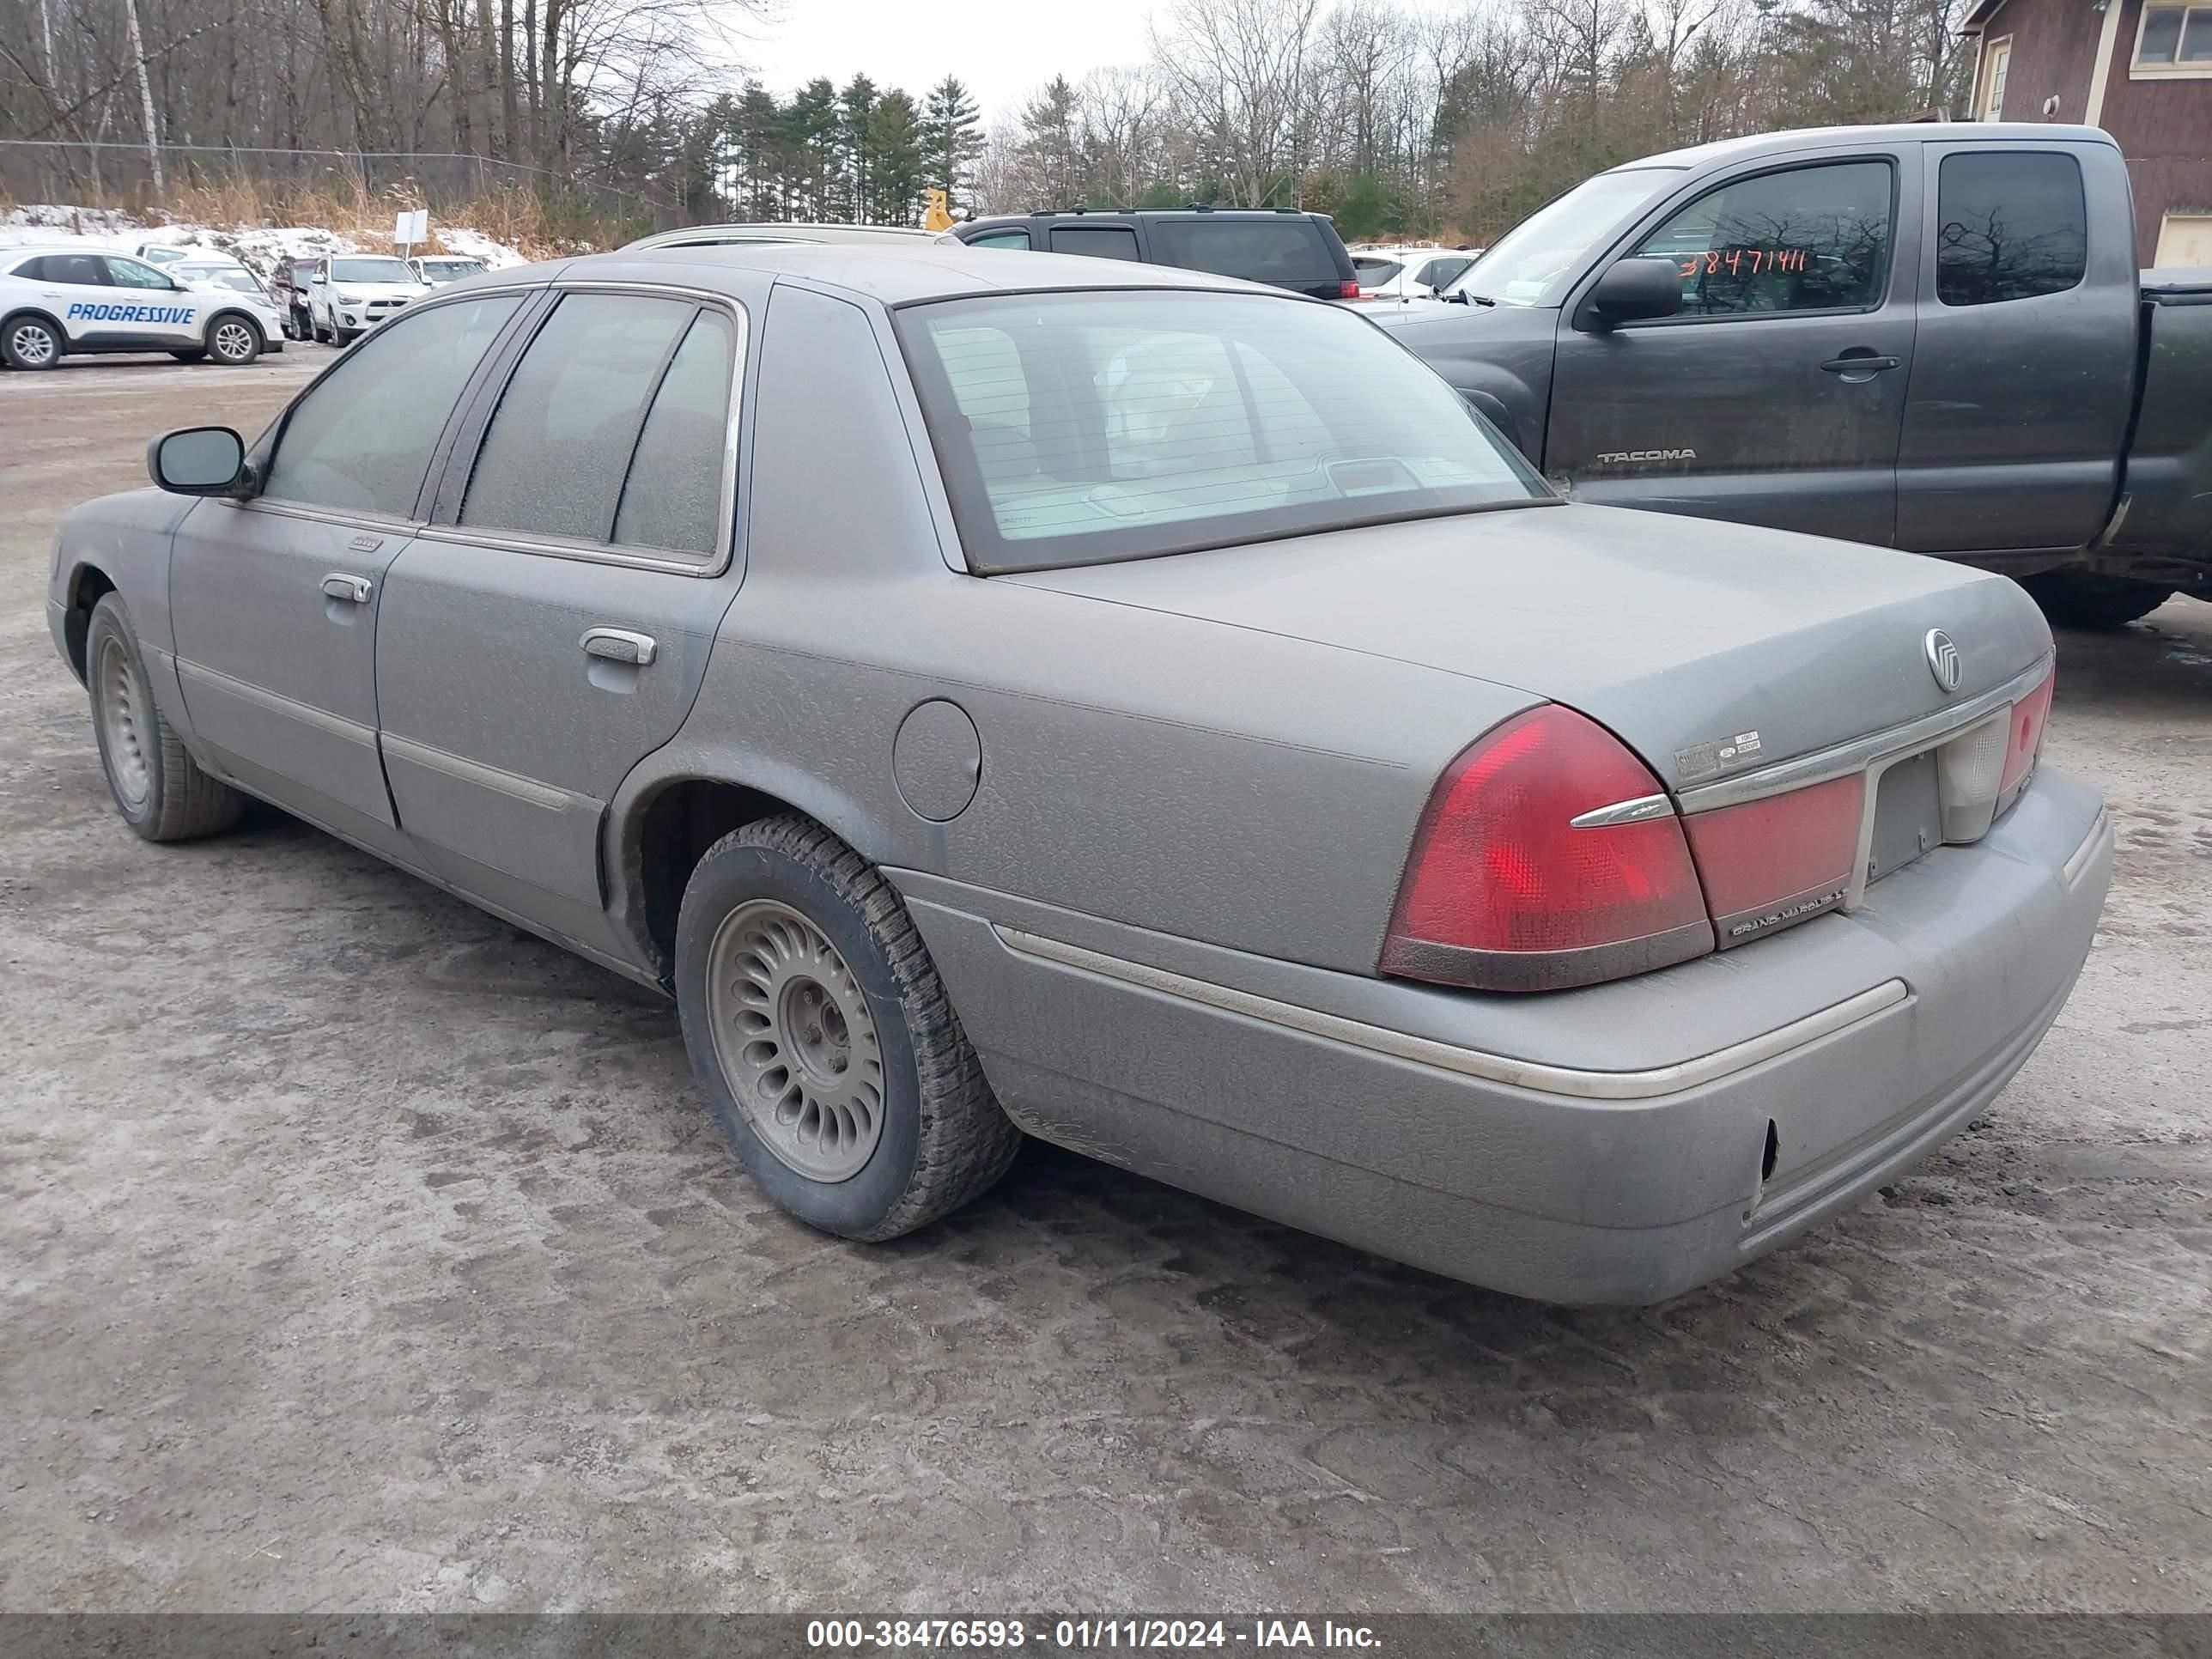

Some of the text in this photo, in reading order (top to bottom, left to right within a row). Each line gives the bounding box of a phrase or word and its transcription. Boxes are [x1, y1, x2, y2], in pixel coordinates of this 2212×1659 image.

[67, 302, 196, 325] PROGRESSIVE
[1597, 449, 1697, 463] TACOMA
[1732, 915, 1781, 936] GRAND
[1781, 896, 1835, 921] MARQUIS
